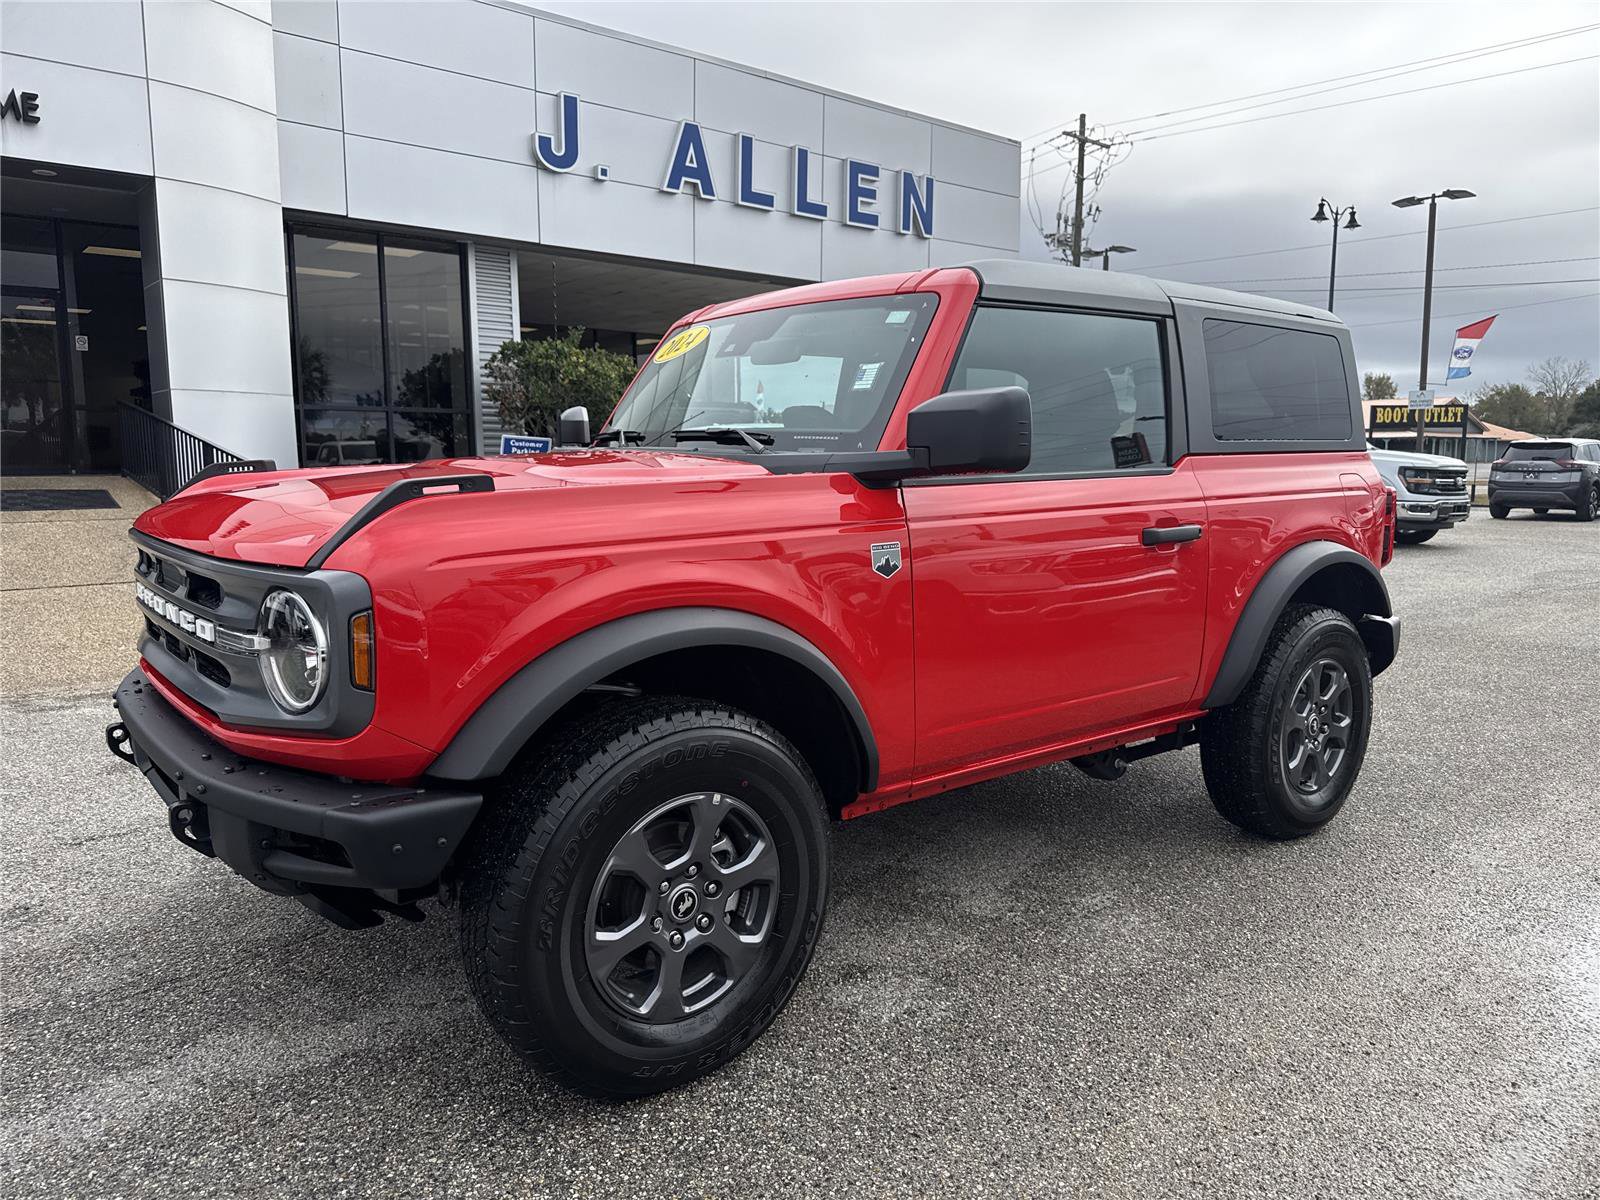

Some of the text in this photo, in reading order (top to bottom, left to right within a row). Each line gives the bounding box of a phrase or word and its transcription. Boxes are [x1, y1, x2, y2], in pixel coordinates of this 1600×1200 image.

[530, 90, 935, 240] J. ALLEN
[656, 328, 705, 360] 2024
[1375, 407, 1409, 423] BOOT
[510, 440, 544, 448] Customer
[136, 581, 215, 642] BRONCO
[538, 740, 731, 950] BRIDGESTONE
